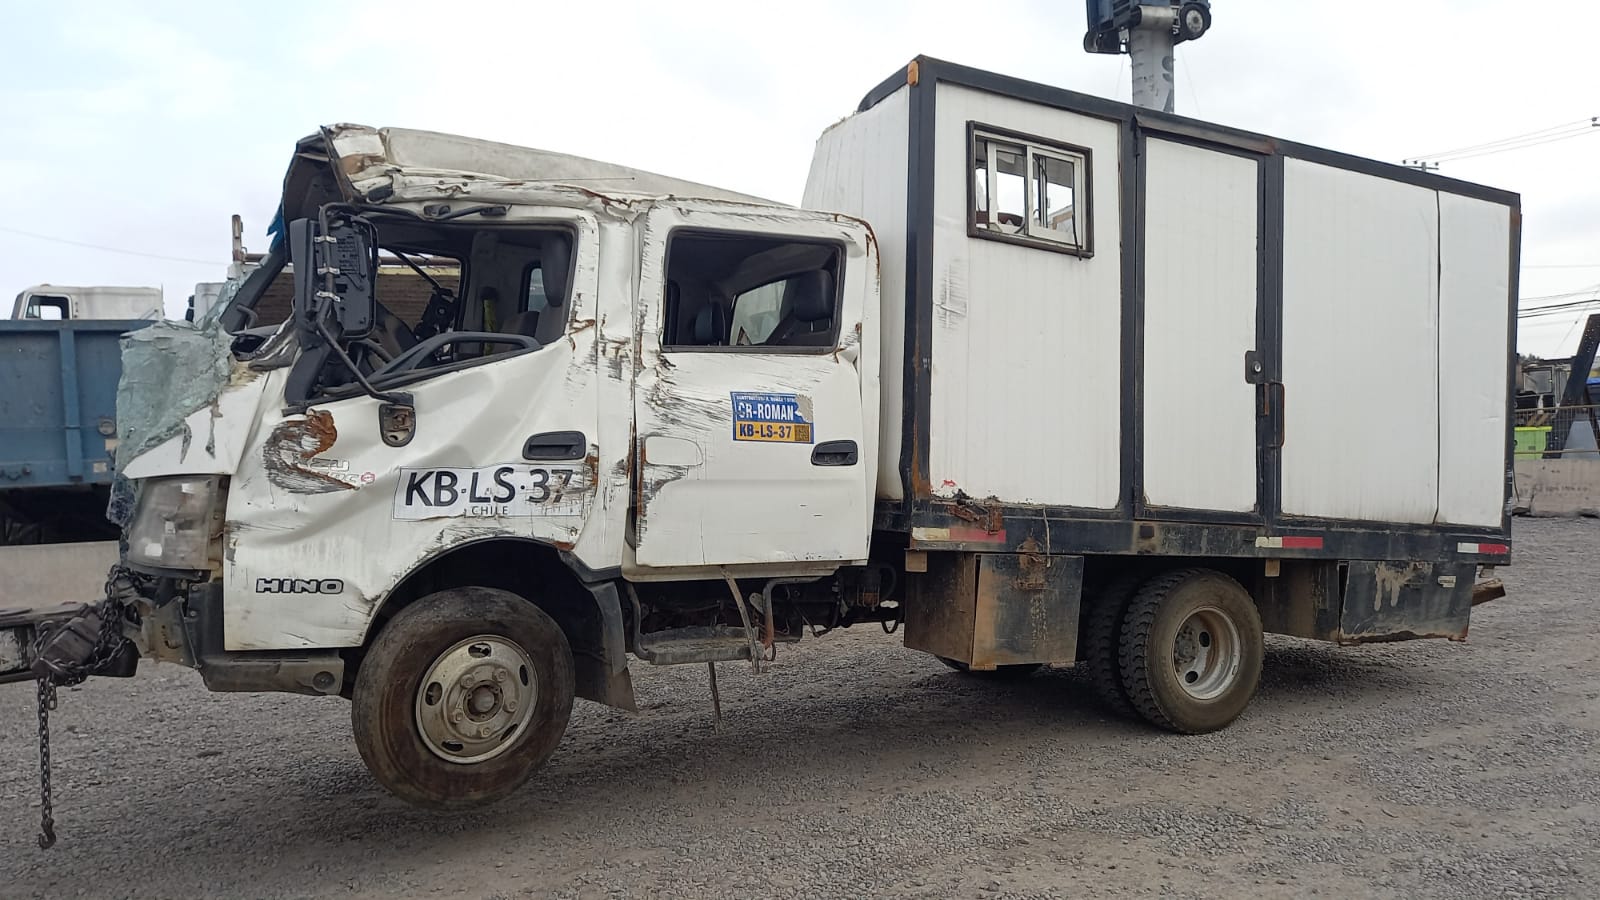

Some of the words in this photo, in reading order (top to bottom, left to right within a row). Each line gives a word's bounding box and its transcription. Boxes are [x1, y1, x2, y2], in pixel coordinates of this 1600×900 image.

[738, 402, 794, 421] CR-ROMAN
[739, 423, 792, 439] KB-LS-37
[471, 505, 509, 516] CHILE
[256, 578, 344, 595] HINO
